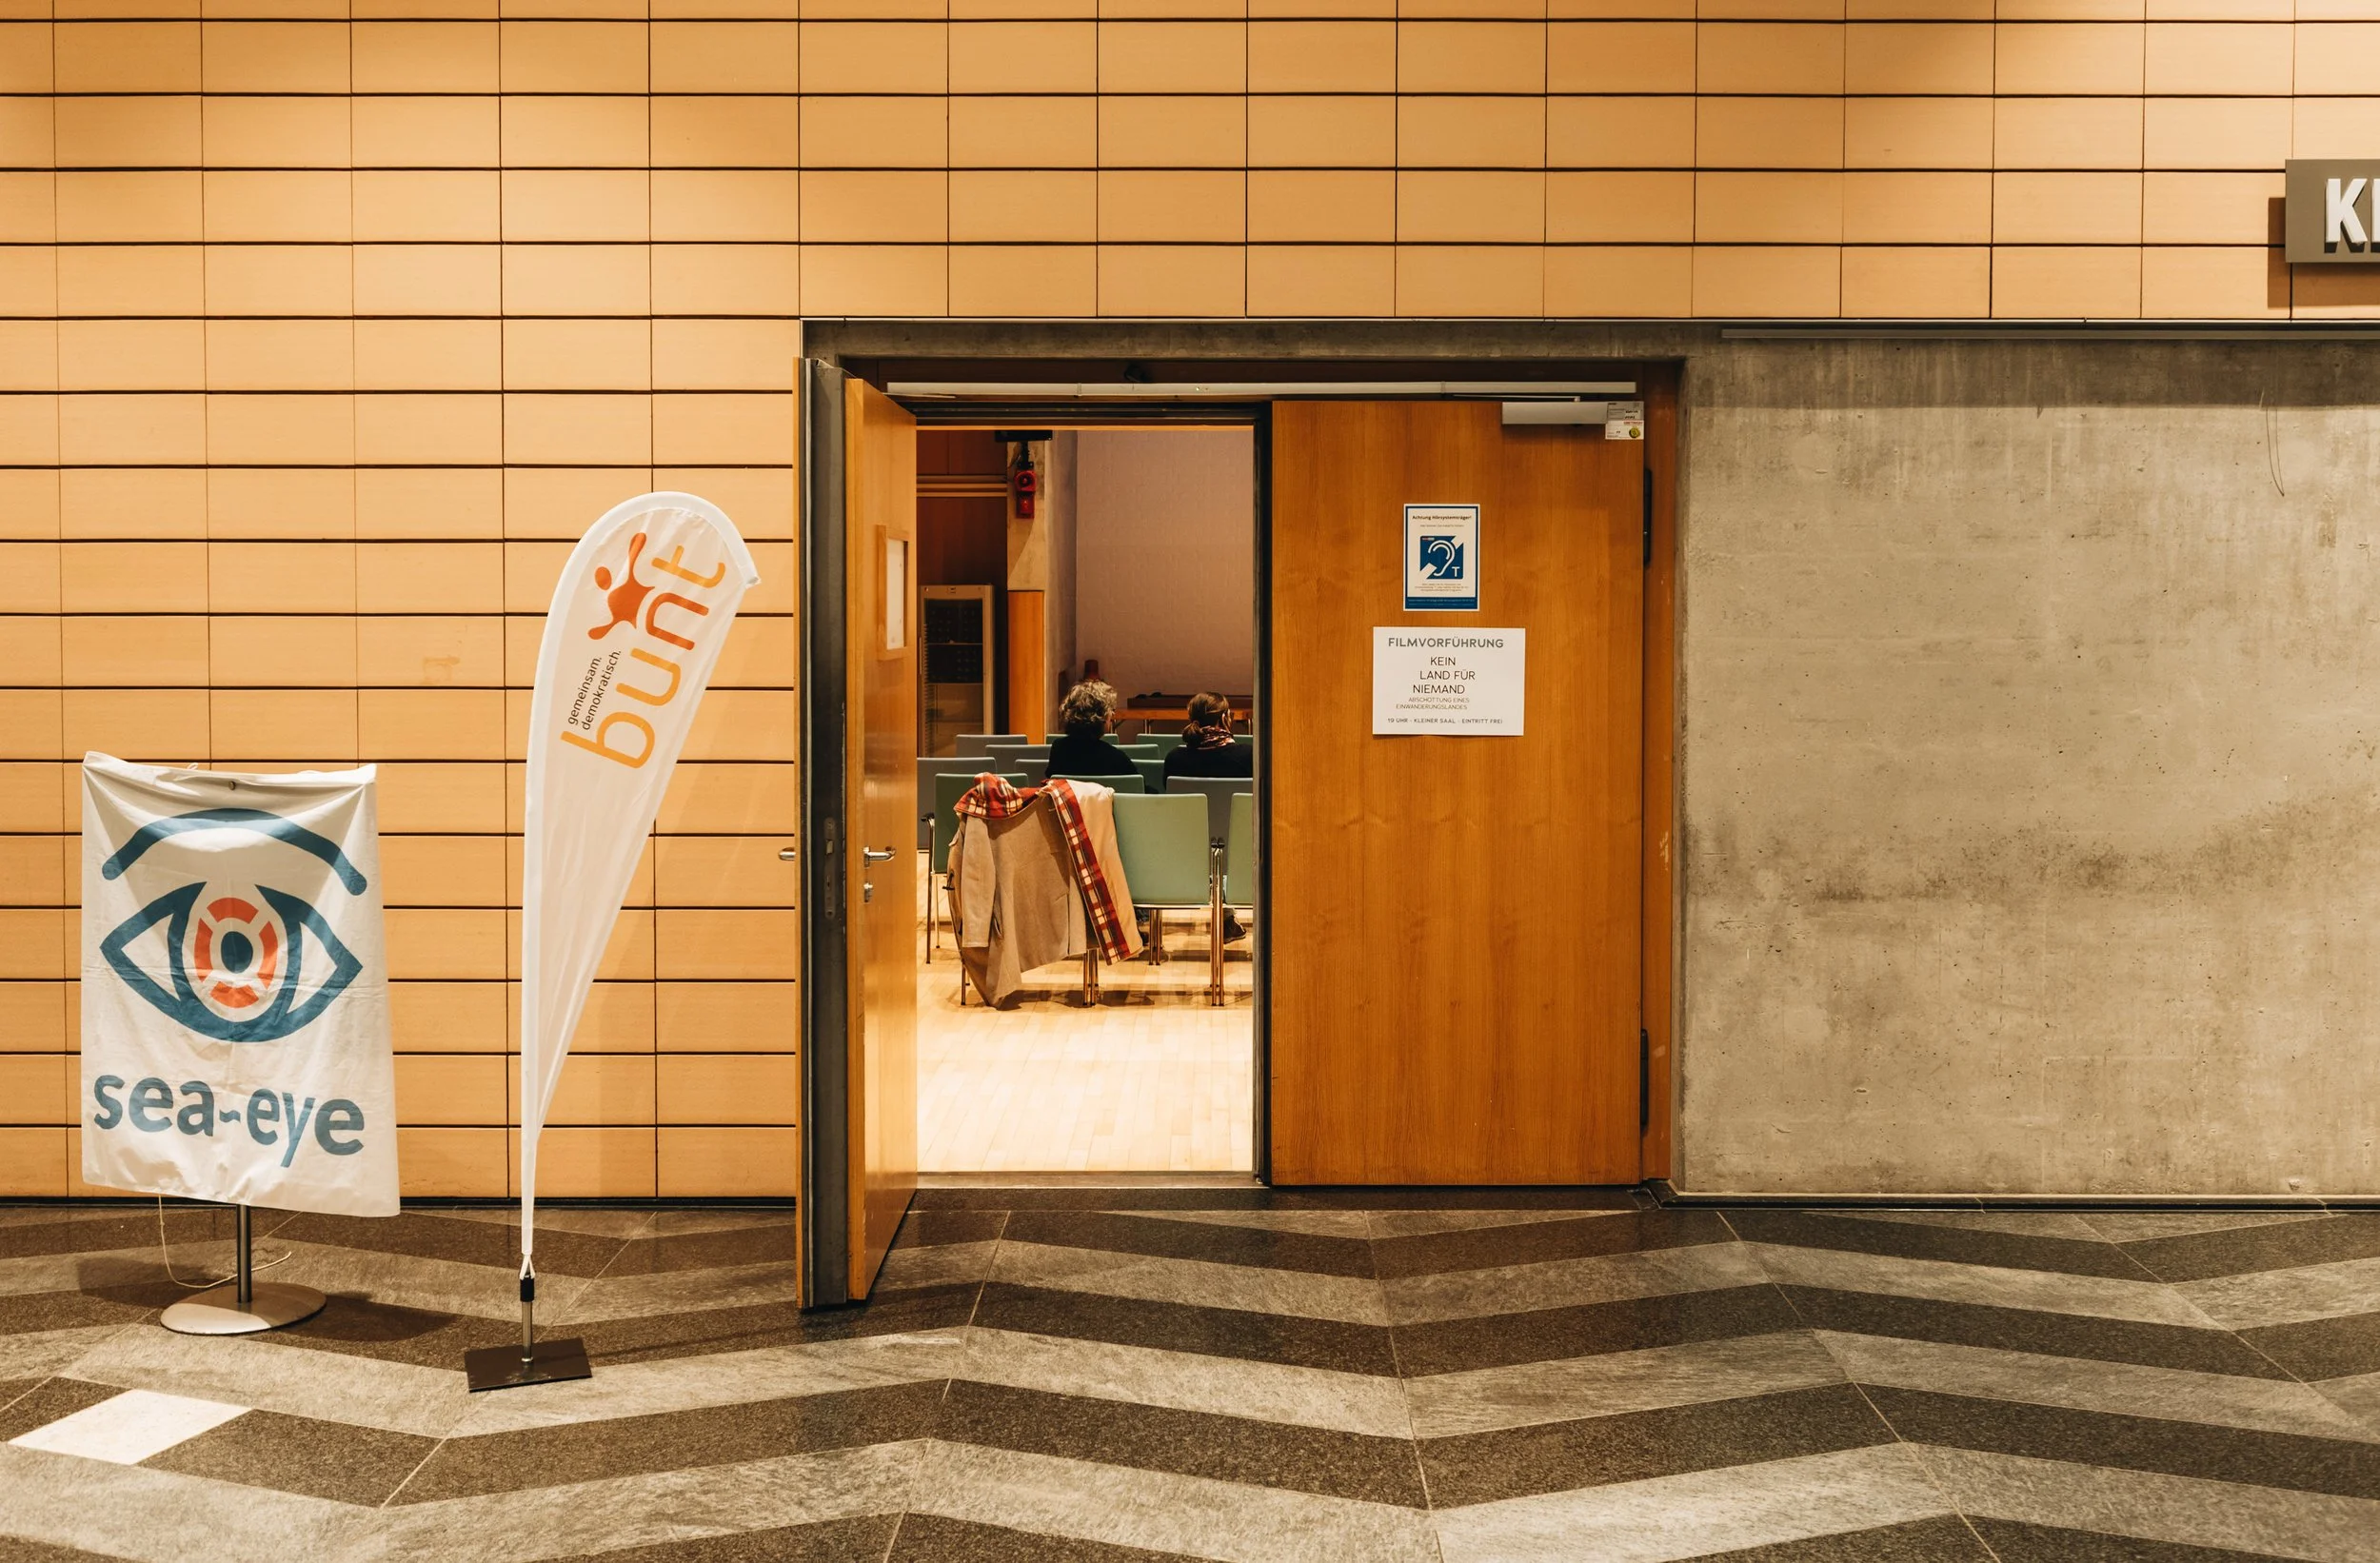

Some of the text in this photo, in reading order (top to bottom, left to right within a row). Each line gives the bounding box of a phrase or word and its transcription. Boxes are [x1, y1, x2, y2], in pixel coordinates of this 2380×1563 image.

[1388, 636, 1504, 648] FILMVORFÜHRUNG
[560, 544, 725, 769] bunt
[1430, 656, 1456, 666] KEIN
[1419, 668, 1476, 681] LAND FÜR
[567, 657, 603, 725] gemeinsam.
[581, 650, 622, 730] demokratisch.
[1413, 683, 1465, 694] NIEMAND
